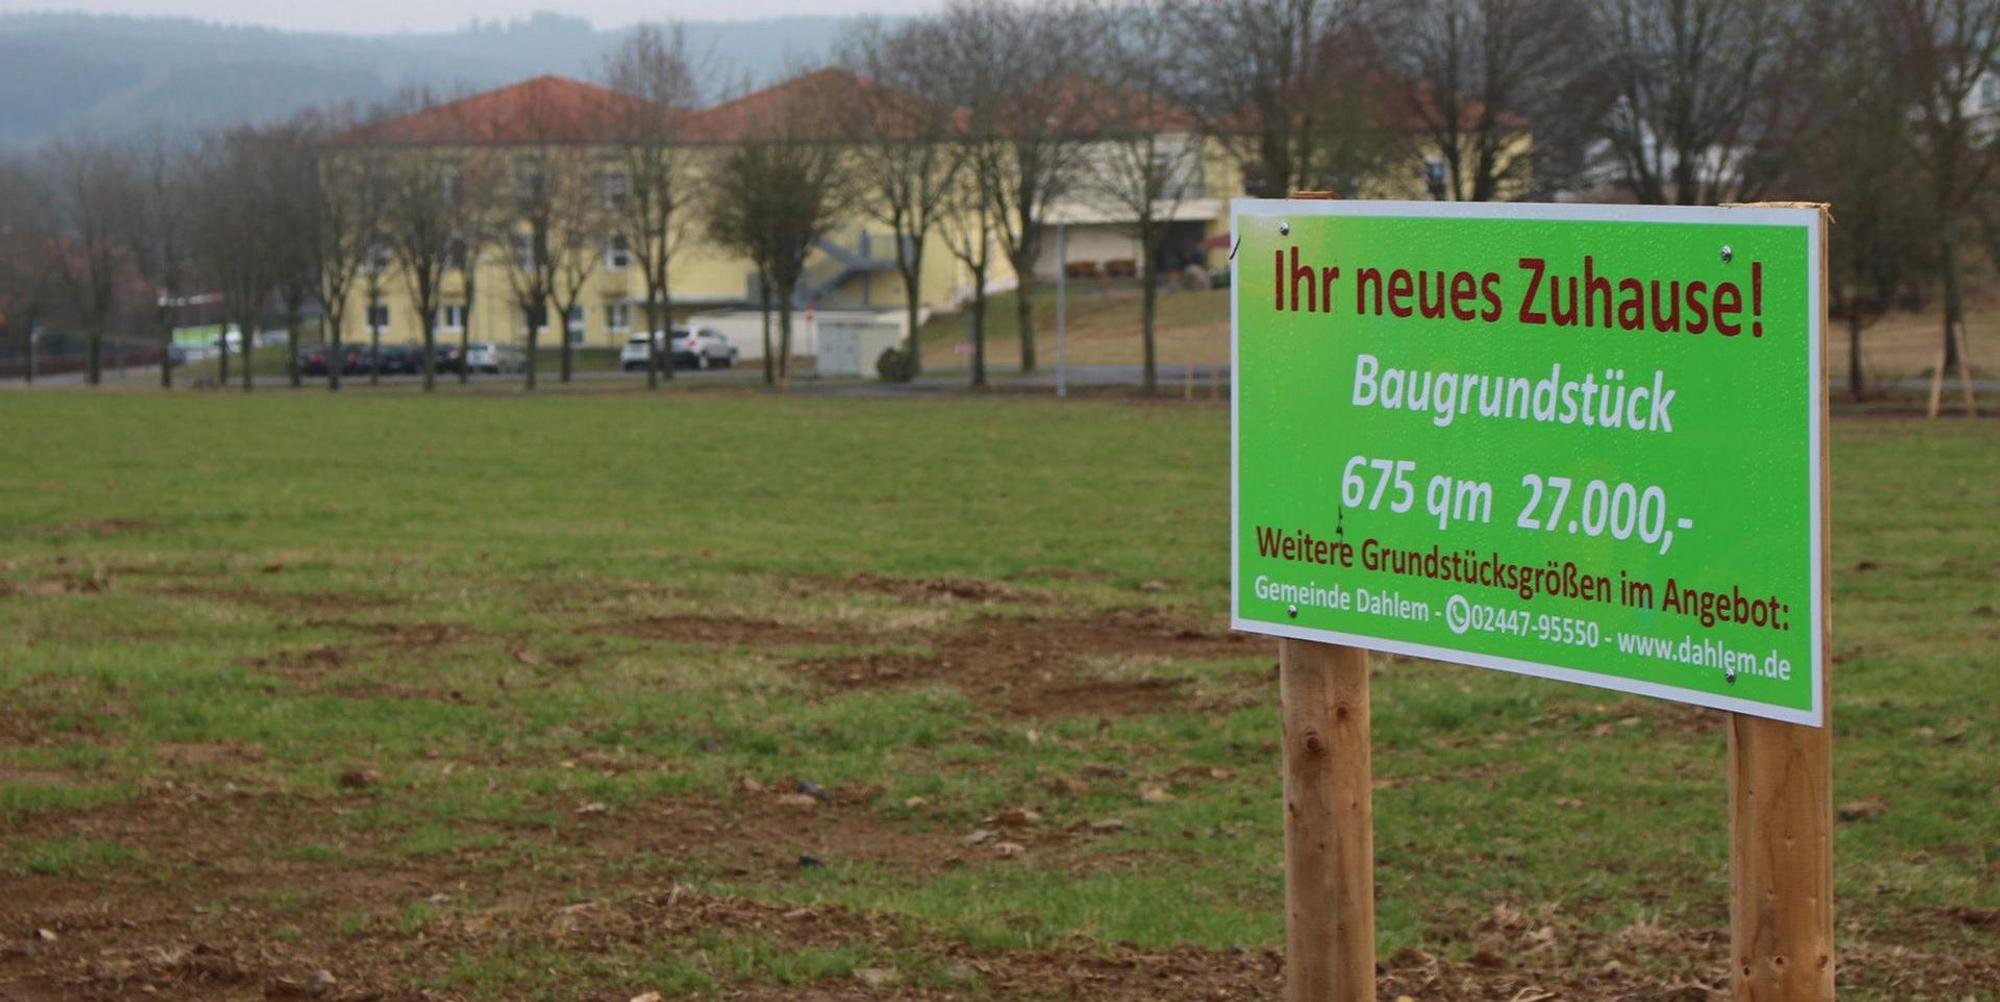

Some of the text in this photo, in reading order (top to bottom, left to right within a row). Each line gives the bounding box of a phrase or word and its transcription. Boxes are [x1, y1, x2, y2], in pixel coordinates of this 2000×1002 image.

[1275, 246, 1764, 338] Ihr neues Zuhause!
[1352, 354, 1676, 433] Baugrundstück
[1341, 455, 1693, 554] 675 qm 27.000,-
[1255, 575, 1351, 611] Gemeinde
[1357, 588, 1429, 622] Dahlem
[1471, 609, 1599, 648] 02447-95550
[1617, 631, 1791, 681] www.dahlem.de
[1256, 526, 1790, 631] Weitere Grundstücksgrößen im Angebot:
